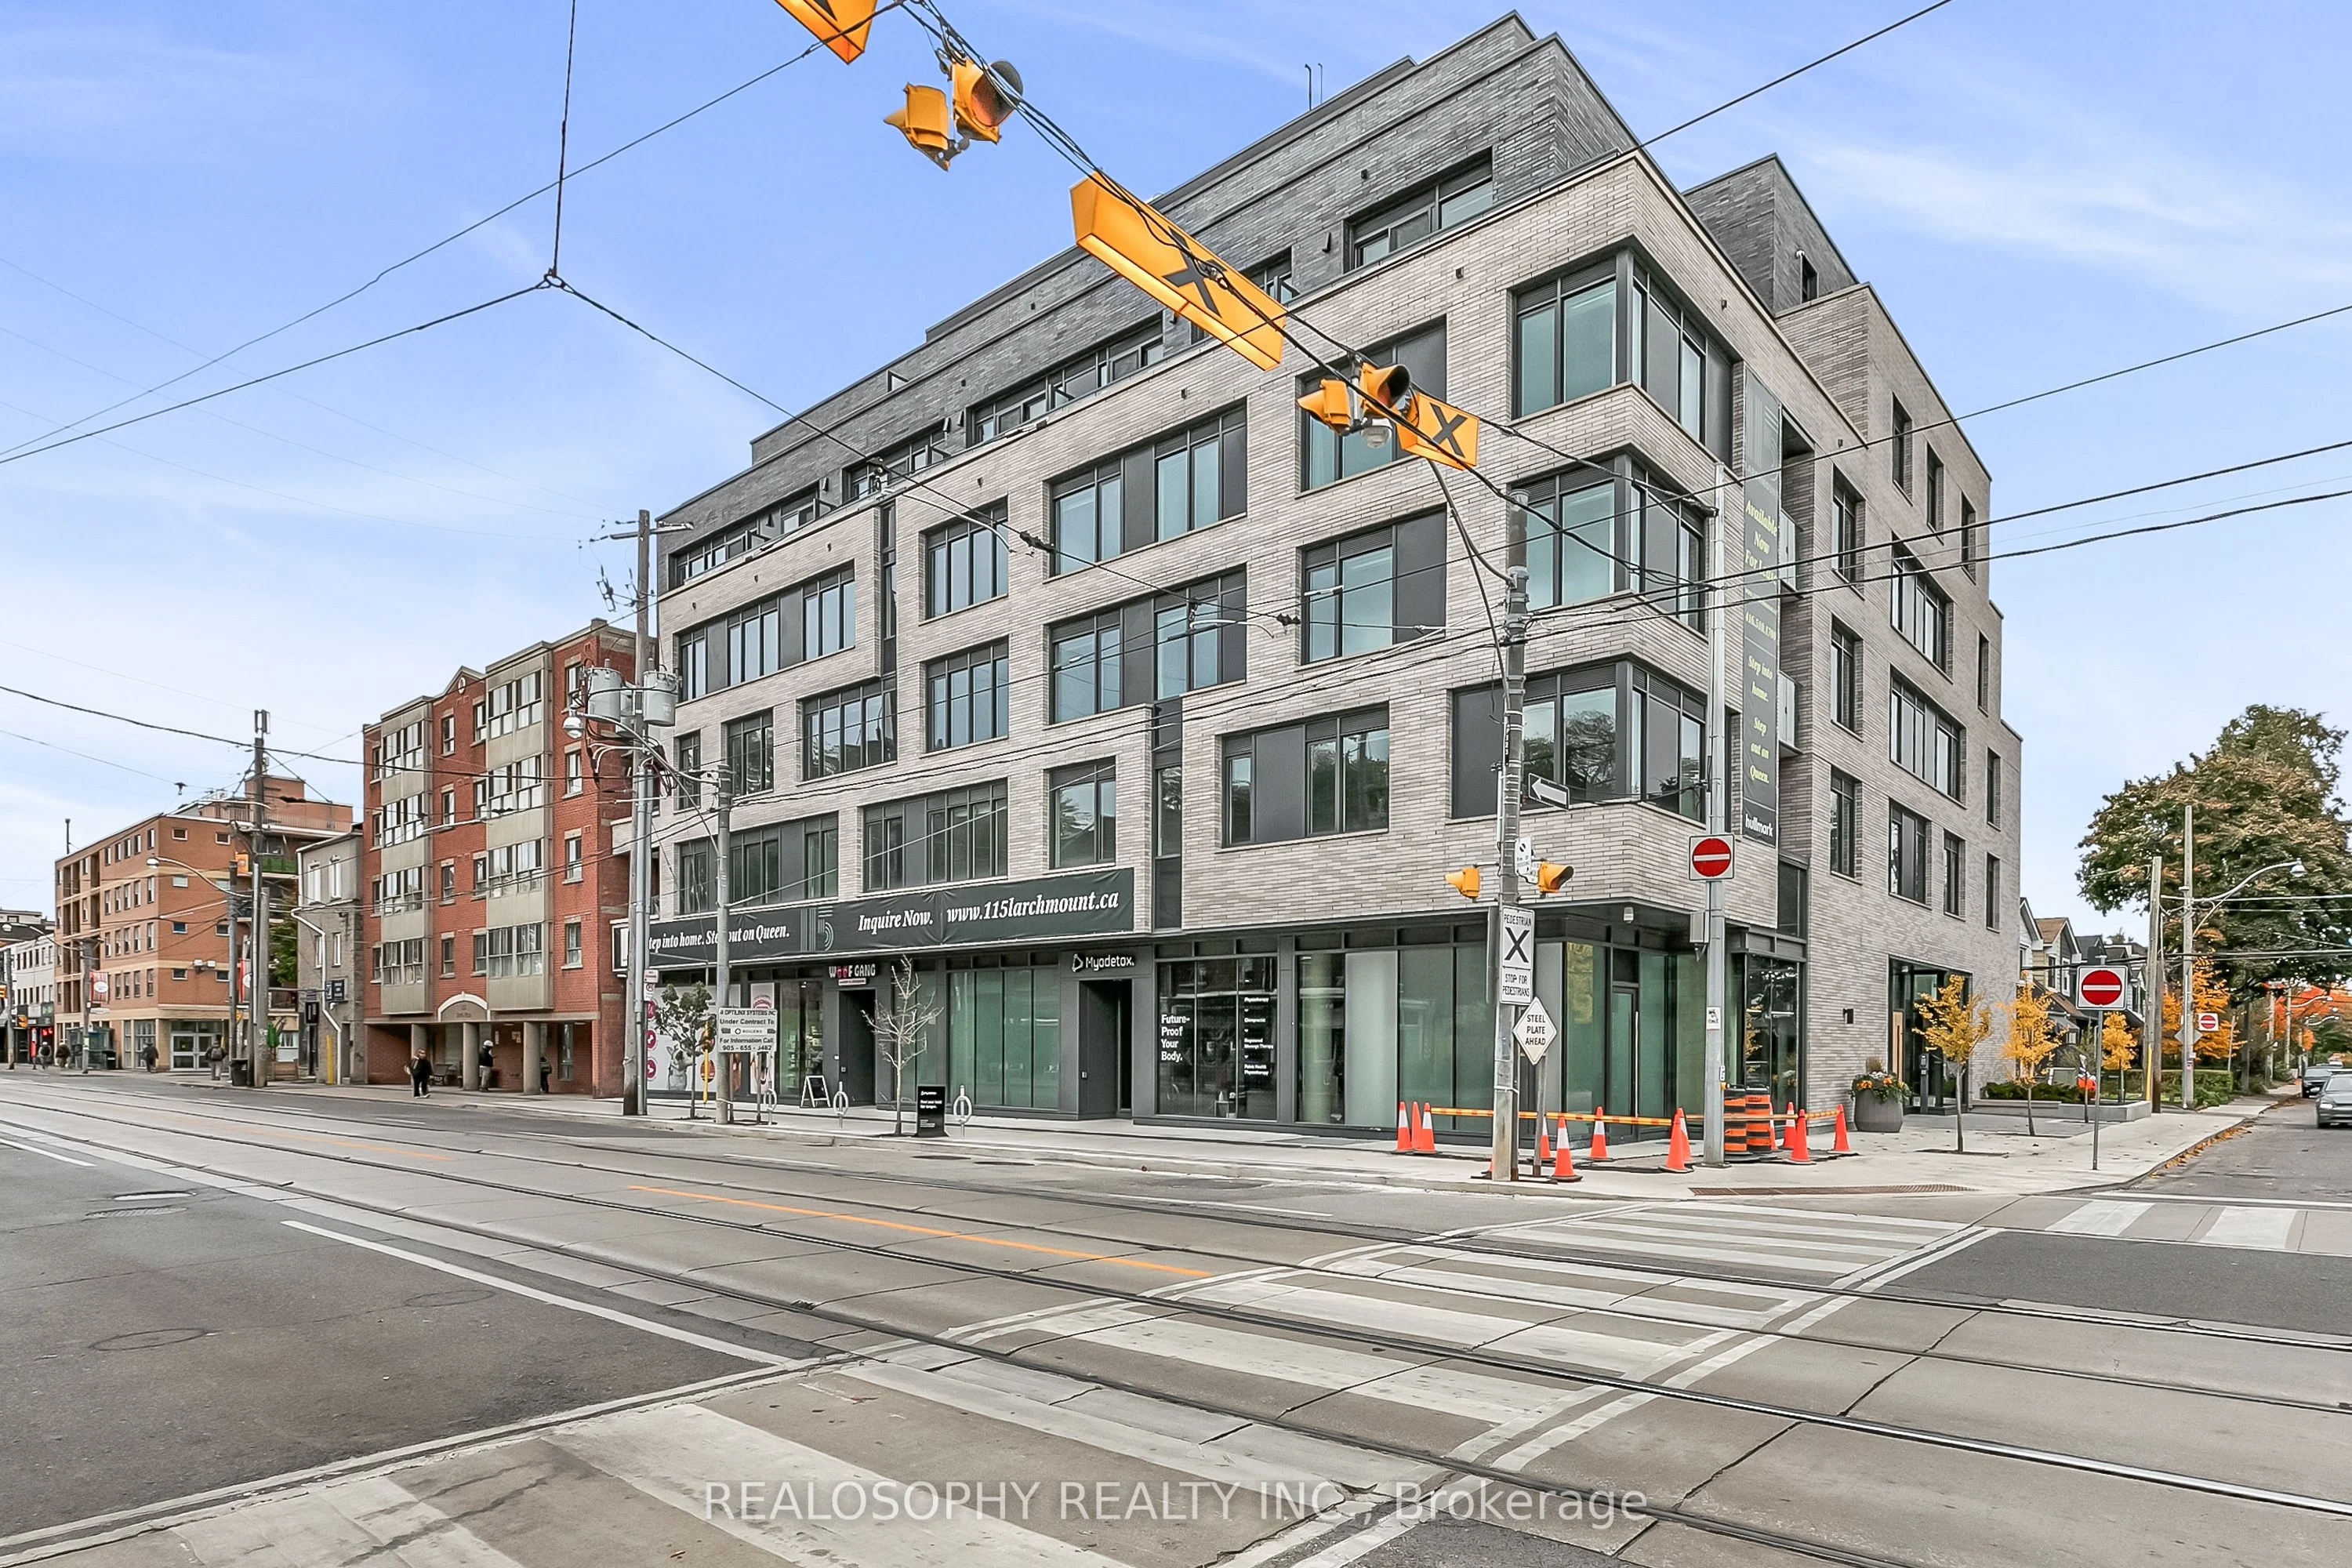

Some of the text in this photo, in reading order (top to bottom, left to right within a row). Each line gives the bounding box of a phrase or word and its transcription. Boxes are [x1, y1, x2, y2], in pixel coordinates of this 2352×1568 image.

[1745, 550, 1758, 570] For
[1748, 655, 1761, 675] Step
[1753, 717, 1767, 737] Step
[1746, 813, 1773, 837] hullmark
[858, 891, 1120, 935] Inquire Now. www.115larchmount.ca
[1504, 913, 1532, 927] PEDESTRIAN
[649, 936, 661, 953] tep
[662, 933, 678, 948] into
[679, 931, 704, 947] home.
[706, 930, 718, 946] Ste
[742, 928, 755, 941] on
[756, 924, 790, 944] Queen.
[855, 964, 876, 977] GANG
[1504, 973, 1528, 985] STOP FOR
[1502, 985, 1530, 997] PEDESTRIANS
[1161, 1014, 1190, 1024] Future-
[1526, 1014, 1546, 1023] STEEL
[1161, 1026, 1183, 1036] Proof
[1526, 1025, 1545, 1035] PLATE
[1161, 1039, 1179, 1048] Your
[1525, 1037, 1546, 1046] AHEAD
[1161, 1051, 1183, 1062] Body.
